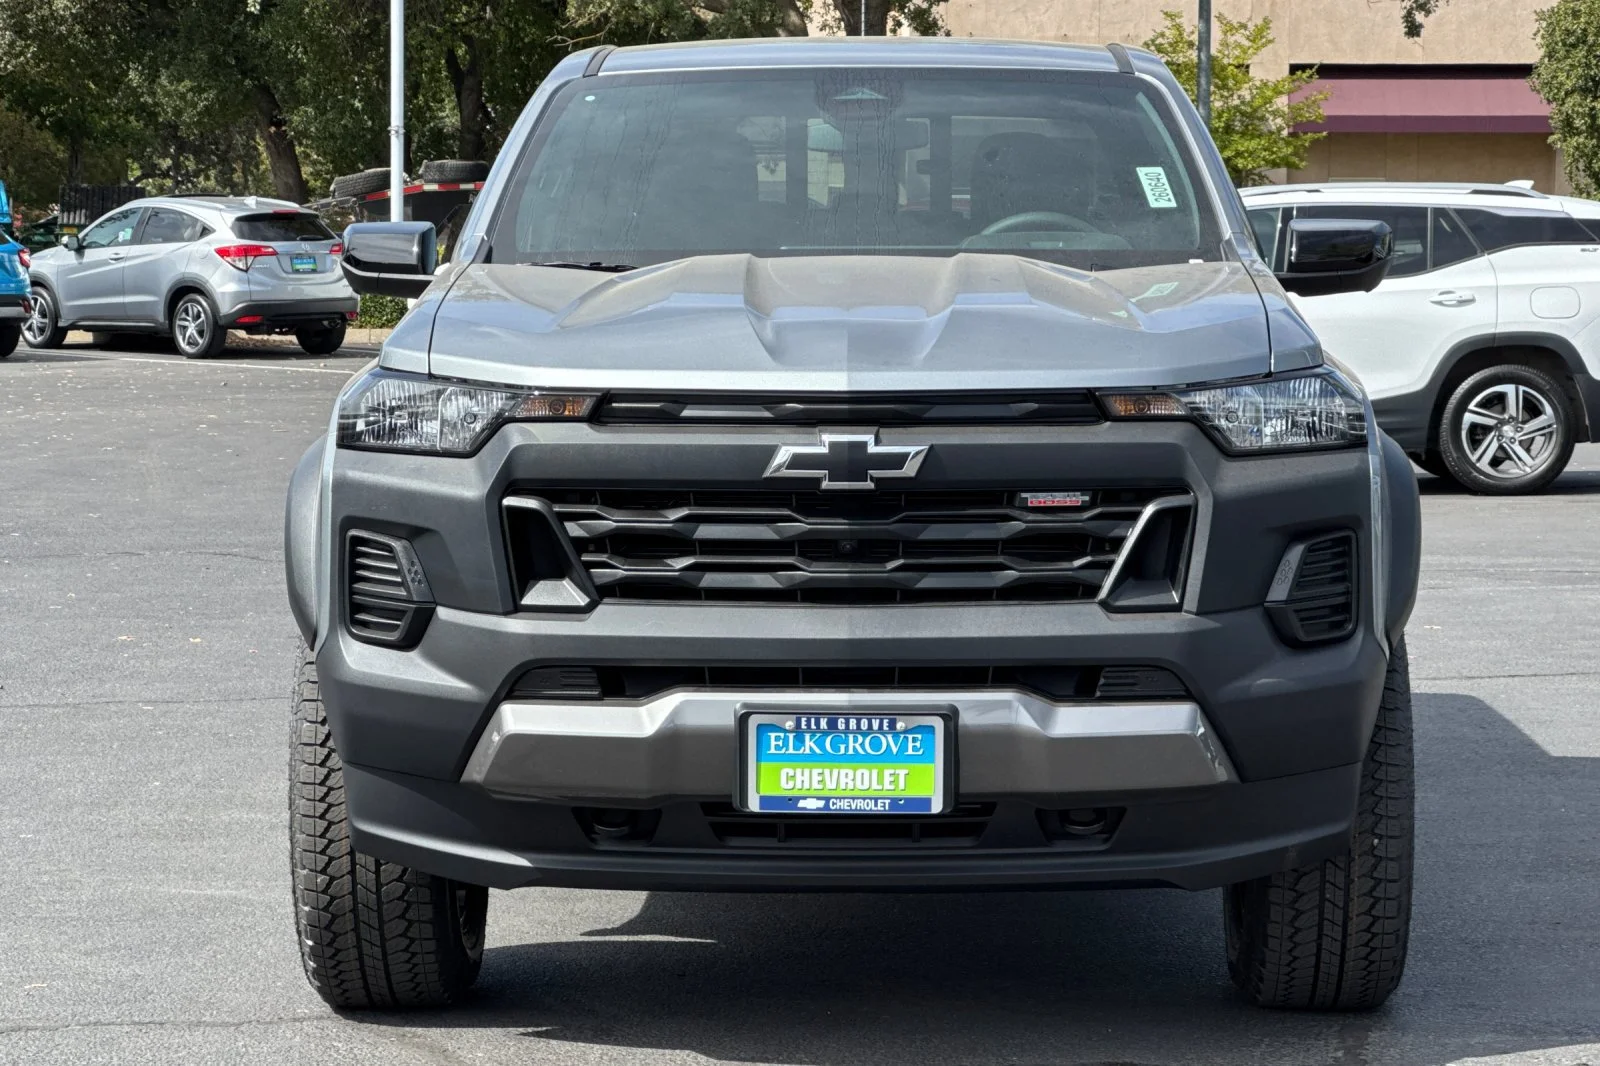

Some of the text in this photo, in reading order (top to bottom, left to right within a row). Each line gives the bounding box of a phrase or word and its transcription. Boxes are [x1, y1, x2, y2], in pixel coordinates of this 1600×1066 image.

[1144, 172, 1172, 203] 260640
[801, 717, 890, 730] ELK GROVE
[768, 732, 923, 755] ELK GROVE
[780, 767, 909, 790] CHEVROLET
[829, 799, 890, 810] CHEVROLET
